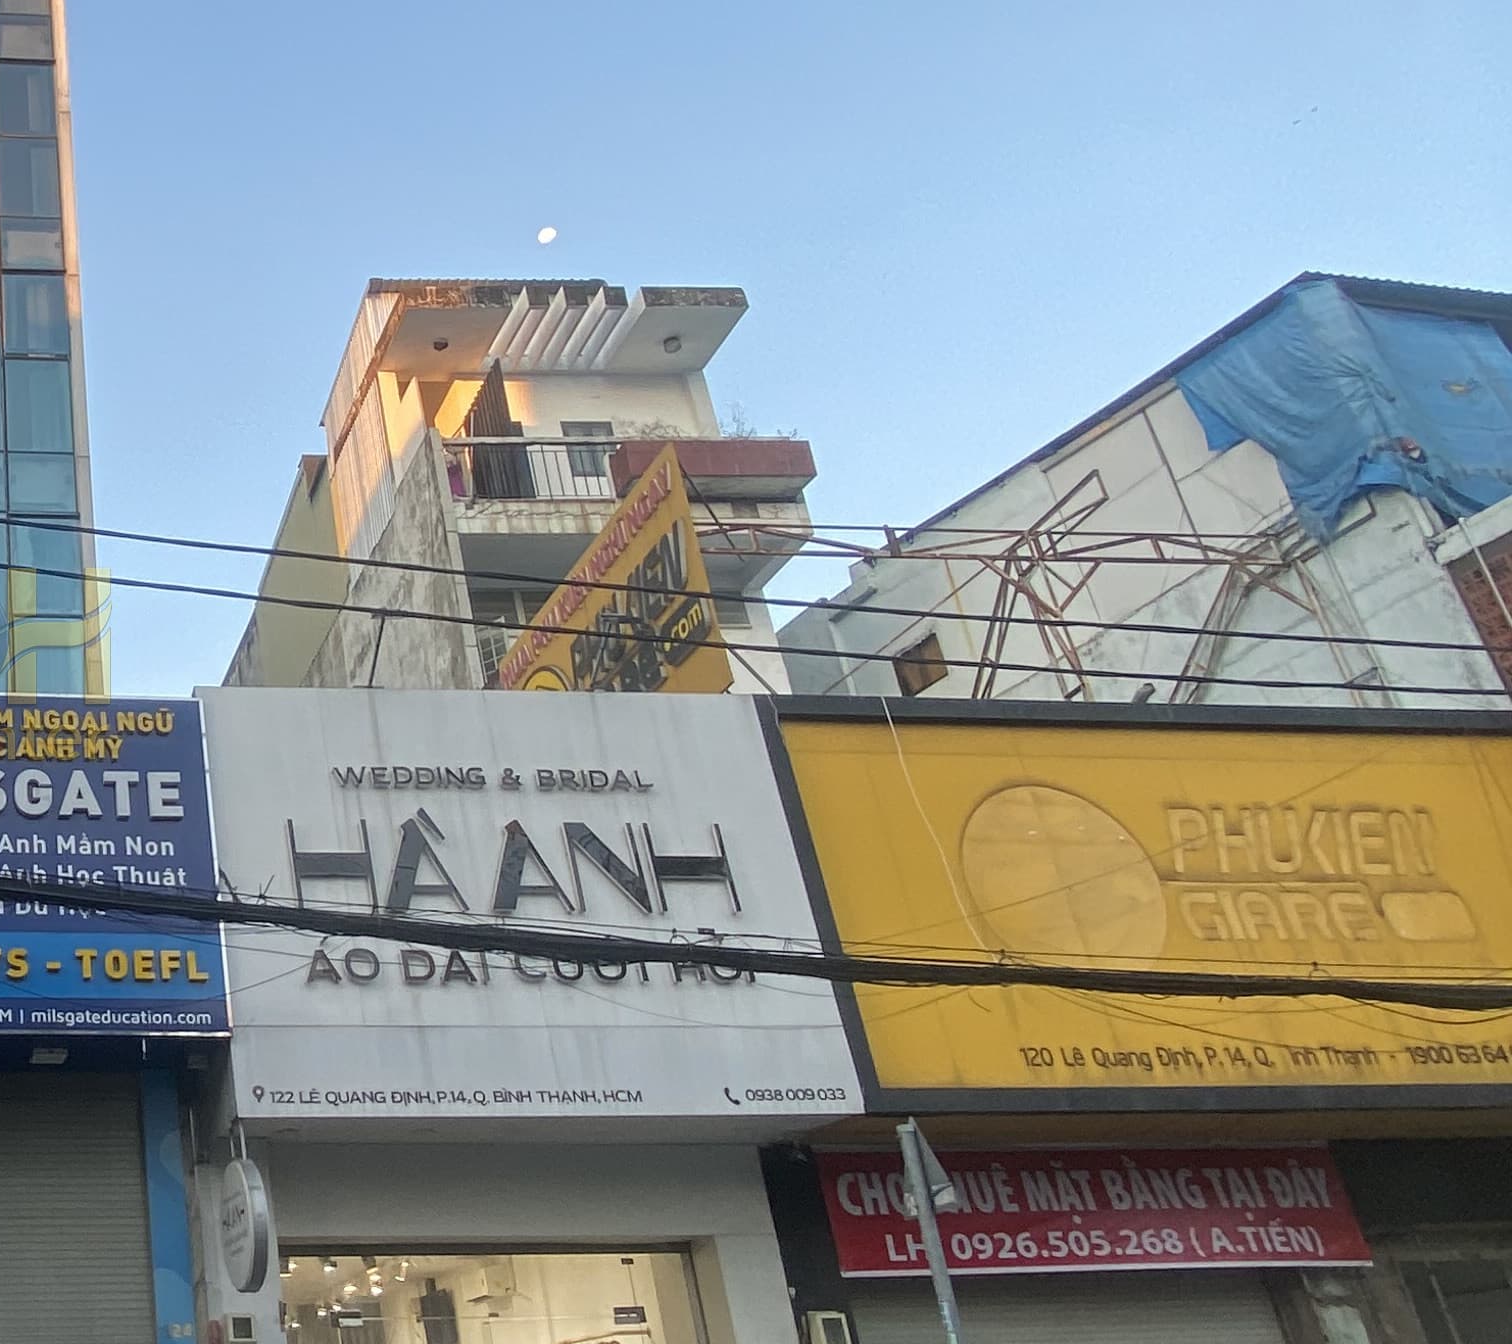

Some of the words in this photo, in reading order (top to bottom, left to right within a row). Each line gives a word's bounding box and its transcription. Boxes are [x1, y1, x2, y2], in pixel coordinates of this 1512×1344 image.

[332, 765, 487, 790] WEDDING
[500, 767, 522, 790] &
[535, 768, 654, 792] BRIDAL
[125, 836, 175, 856] Non
[491, 818, 743, 916] ANH
[75, 949, 210, 982] TOEFL
[31, 1008, 212, 1027] milsgateducation.com
[1019, 1047, 1054, 1067] 120
[1061, 1046, 1086, 1067] Lê
[1091, 1046, 1153, 1071] Quang
[270, 1091, 295, 1104] 122
[325, 1091, 387, 1107] QUANG
[745, 1088, 784, 1102] 0938
[786, 1088, 816, 1101] 009
[818, 1088, 847, 1101] 033
[950, 1228, 1185, 1261] 0926.505.268
